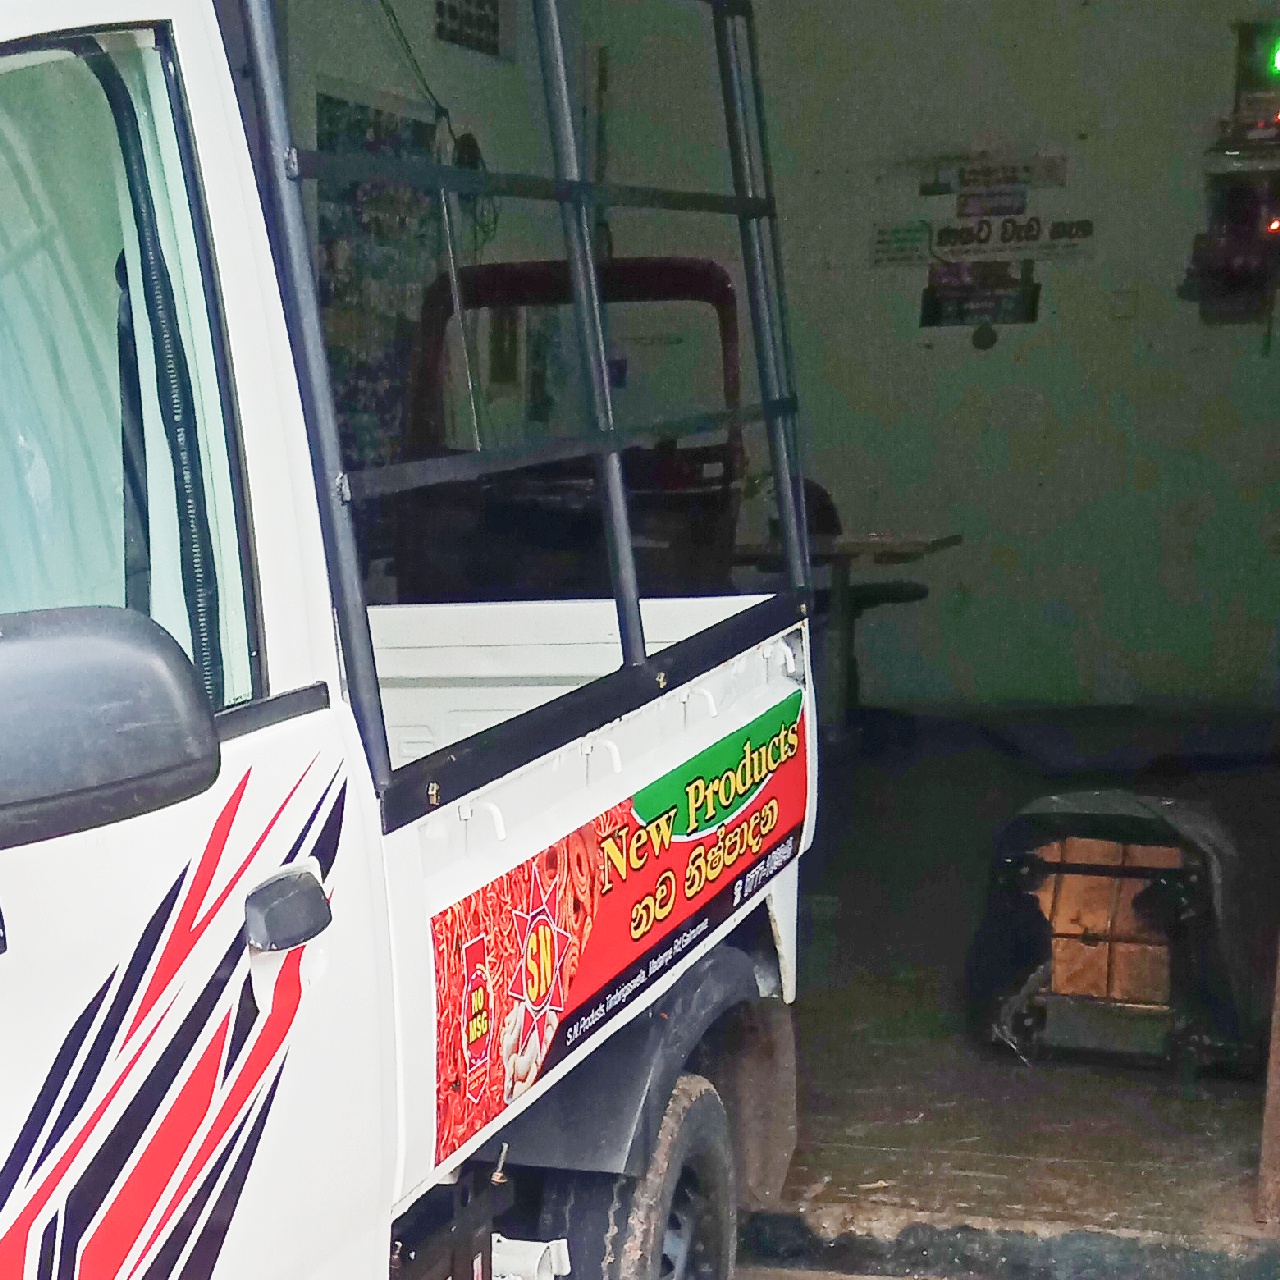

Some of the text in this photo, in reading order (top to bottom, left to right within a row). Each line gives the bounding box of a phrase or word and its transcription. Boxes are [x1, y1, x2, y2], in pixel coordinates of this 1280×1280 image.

[601, 721, 798, 895] New Products
[630, 869, 676, 939] නව
[526, 924, 553, 1003] SN
[469, 1010, 488, 1043] MSG
[471, 986, 485, 1016] NO
